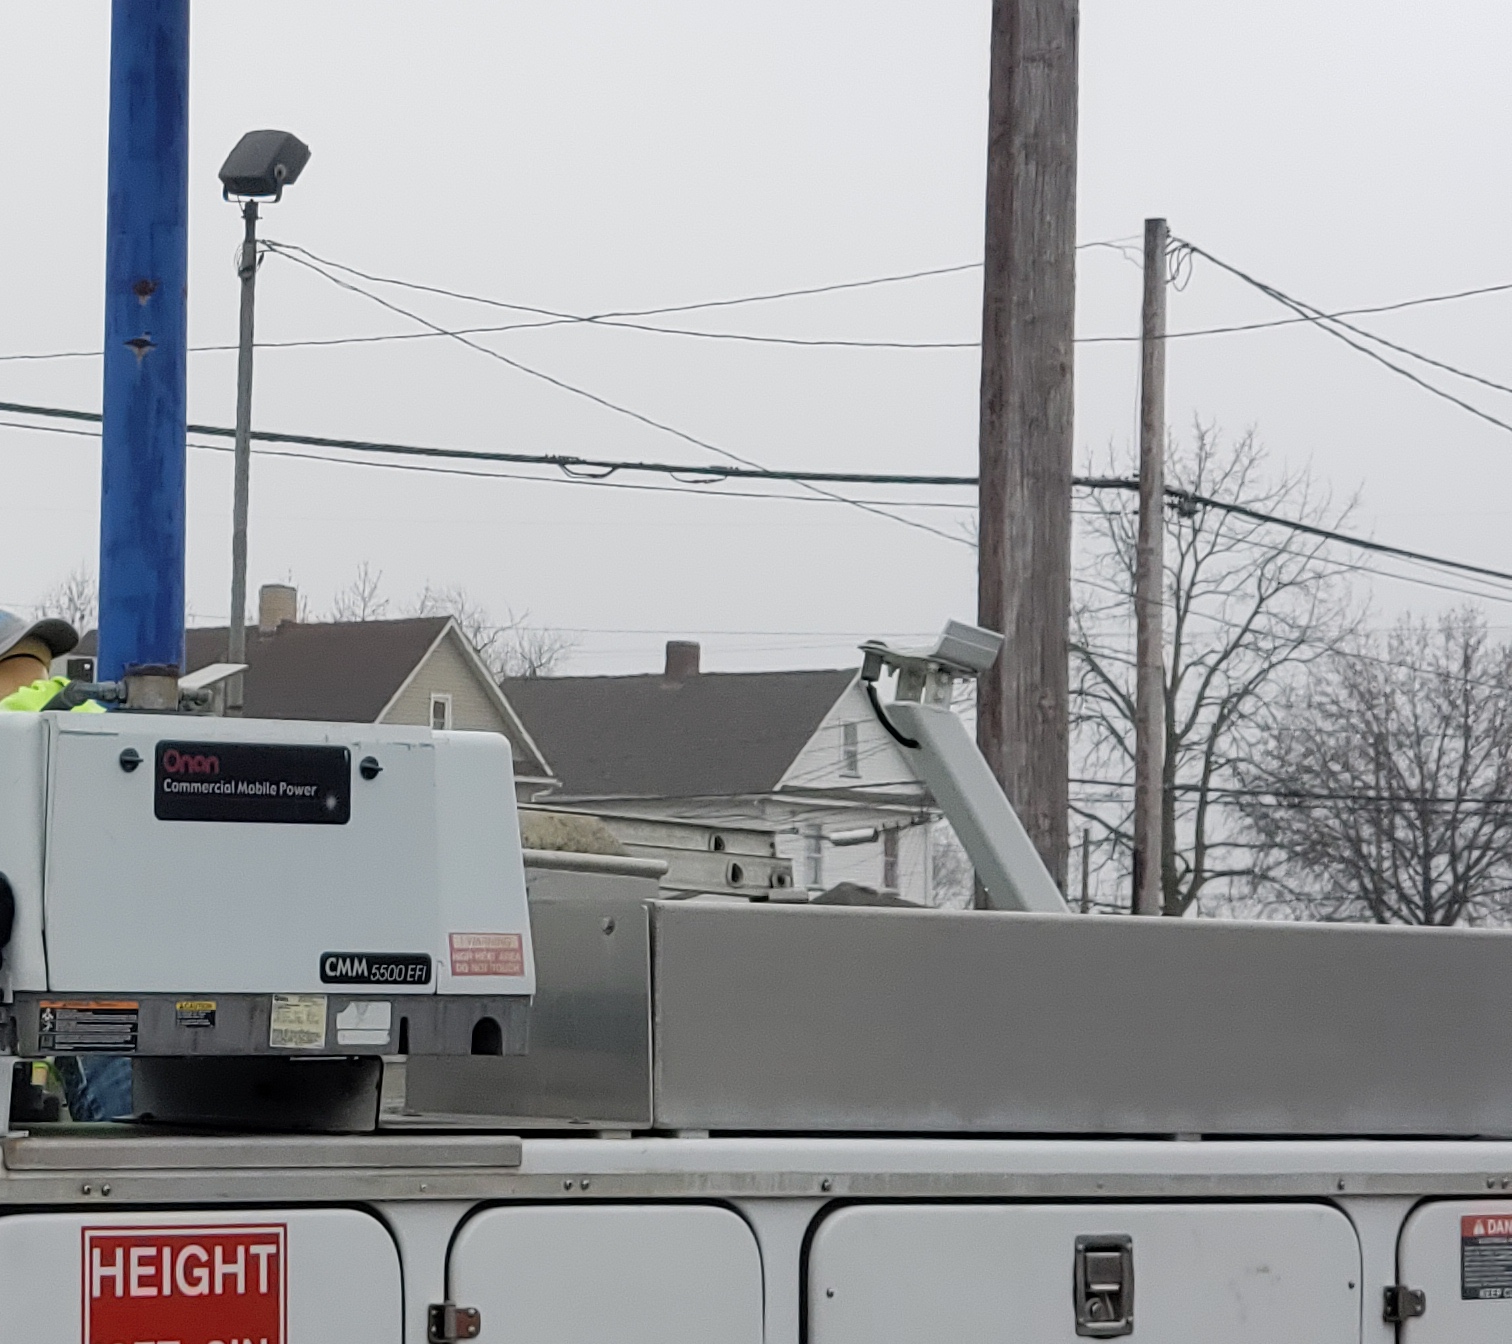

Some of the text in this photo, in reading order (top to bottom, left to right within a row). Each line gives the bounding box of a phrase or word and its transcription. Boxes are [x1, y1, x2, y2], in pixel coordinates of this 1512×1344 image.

[163, 748, 220, 774] Onan
[163, 778, 318, 797] Commercial Mobile Power
[325, 957, 427, 981] CMM 5500 EFI
[91, 1244, 277, 1298] HEIGHT
